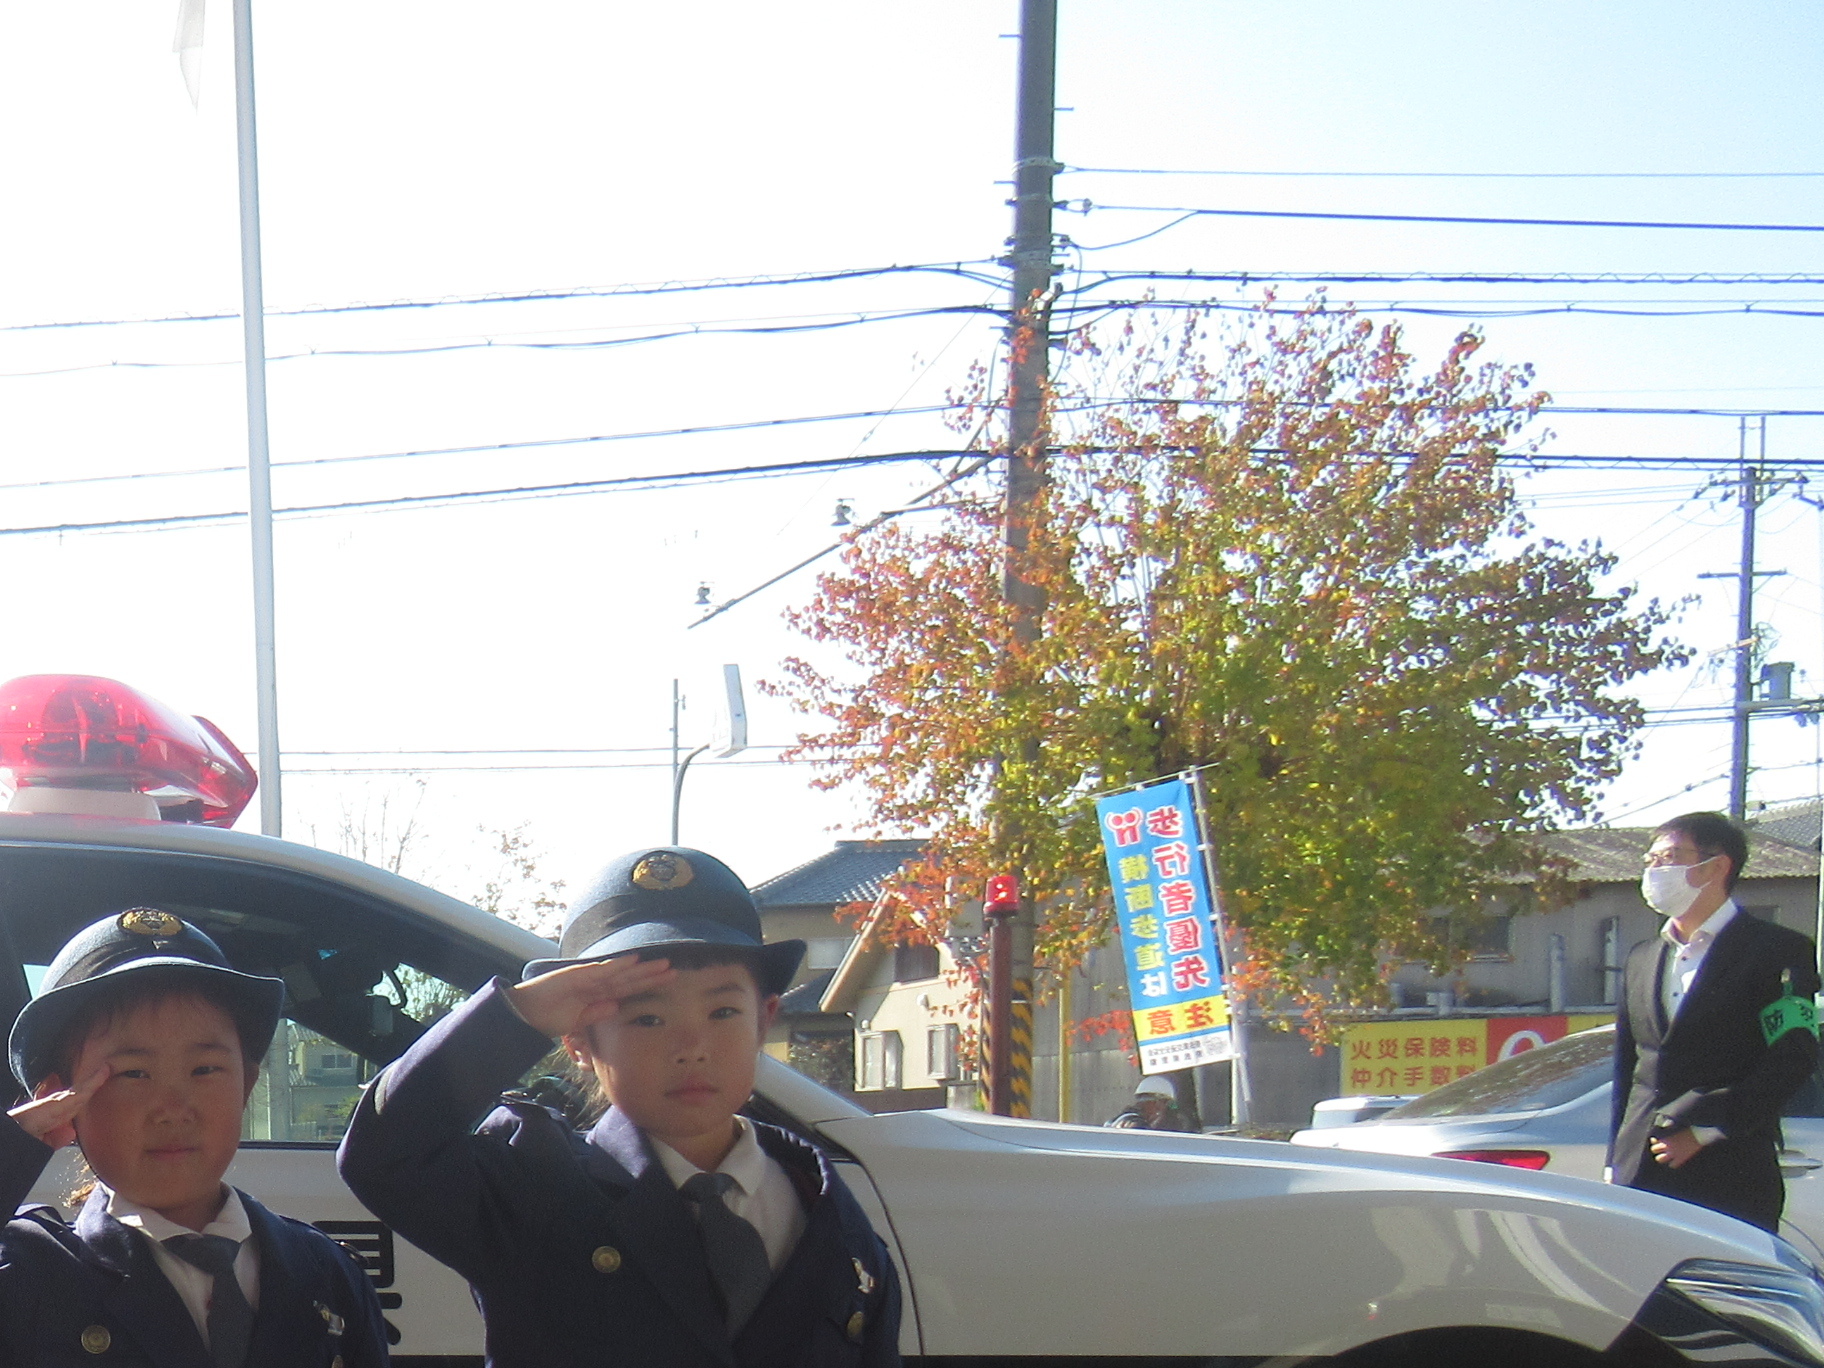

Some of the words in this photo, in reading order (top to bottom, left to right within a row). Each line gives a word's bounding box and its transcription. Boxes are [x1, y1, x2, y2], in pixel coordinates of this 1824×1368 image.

[1350, 1036, 1479, 1061] 火災保険料
